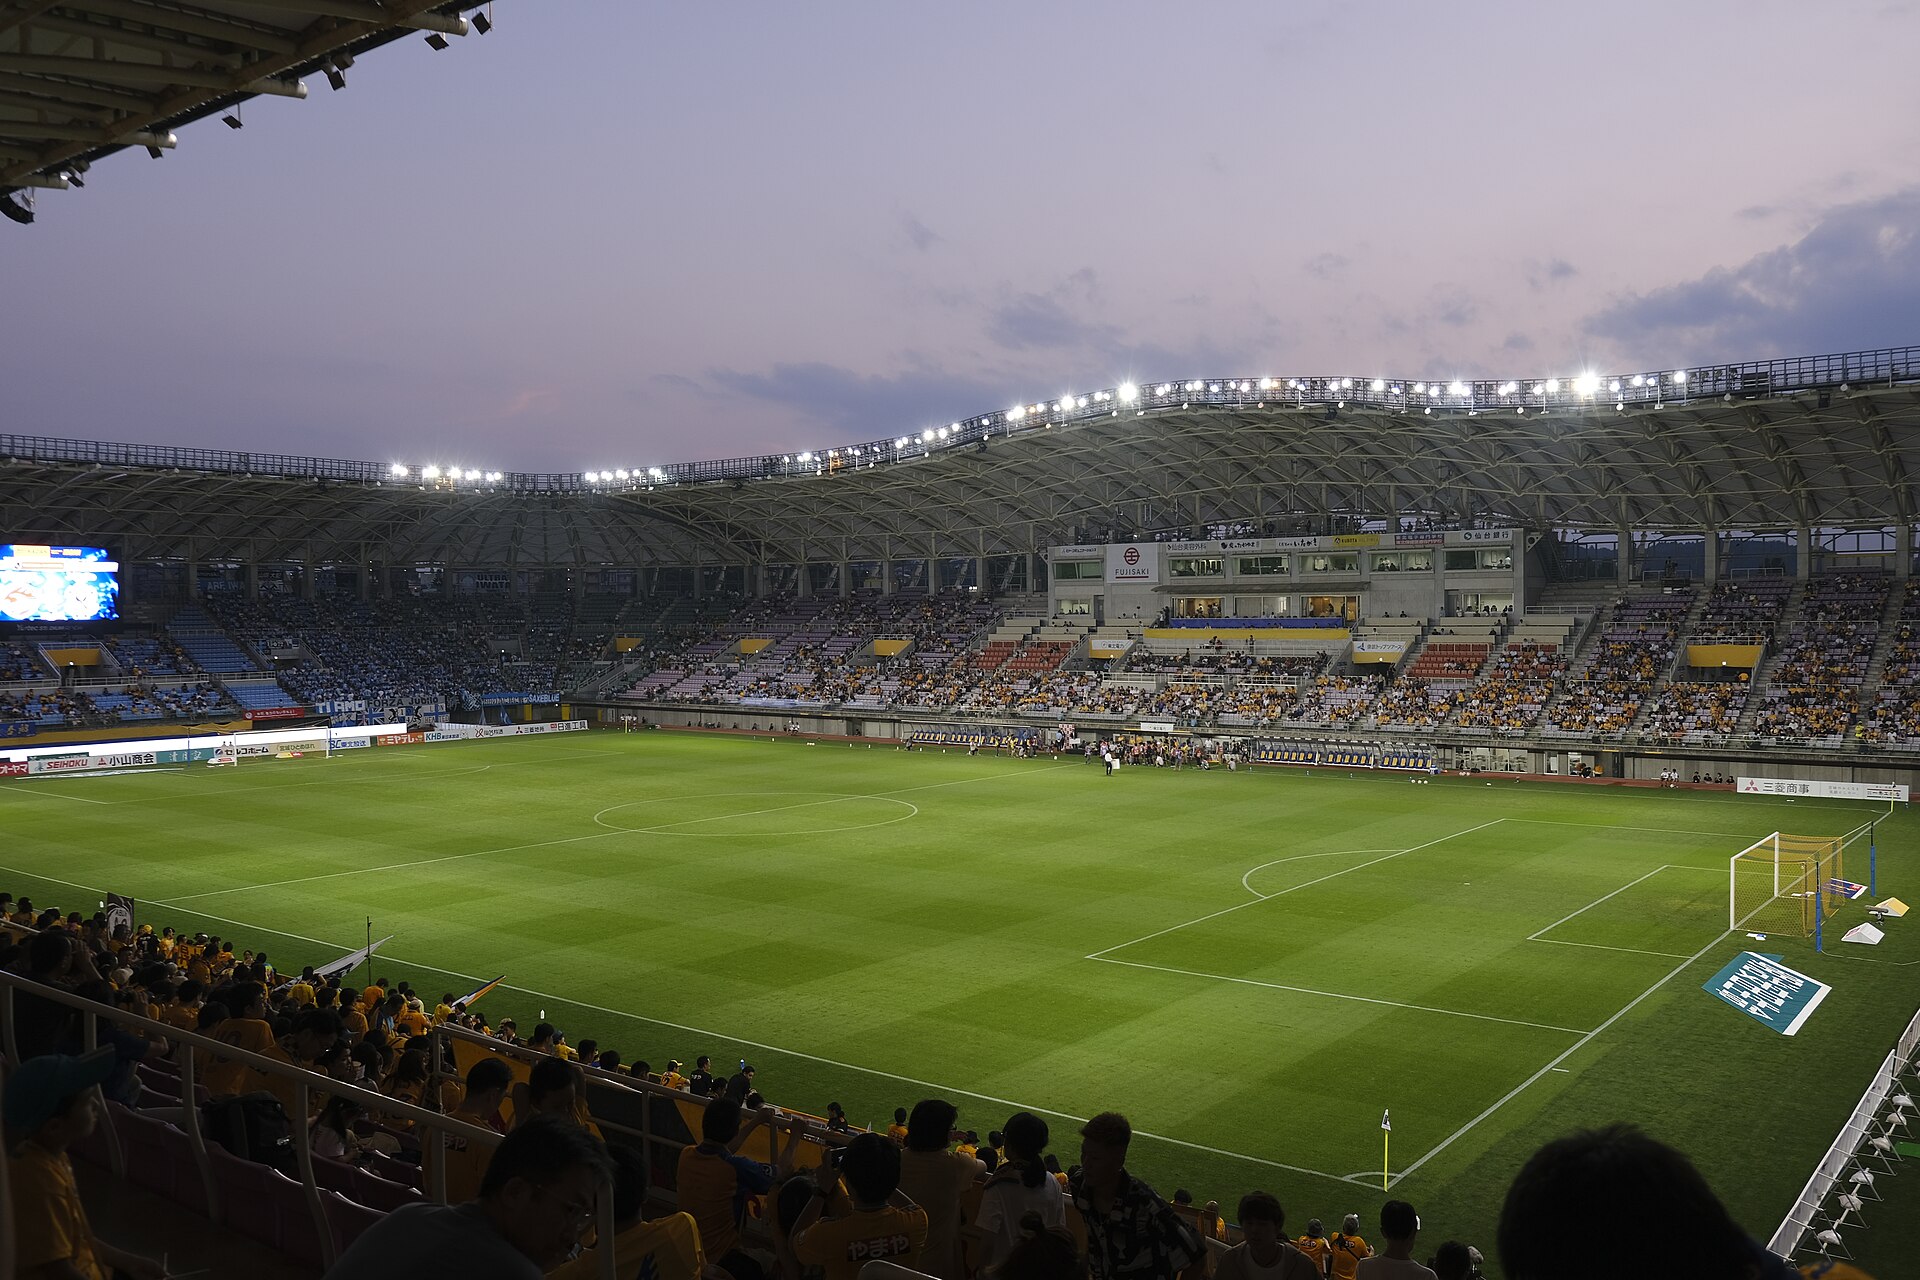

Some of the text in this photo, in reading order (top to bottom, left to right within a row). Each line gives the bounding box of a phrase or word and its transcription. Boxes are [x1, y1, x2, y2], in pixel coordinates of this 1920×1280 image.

[1474, 530, 1509, 539] 仙台銀行
[368, 699, 403, 708] FORZA
[387, 735, 414, 744] ミヤテレ
[47, 759, 88, 769] SEIHOKU
[110, 753, 154, 766] 小山商会
[1763, 782, 1810, 794] 三菱商事
[849, 1235, 909, 1260] やまや
